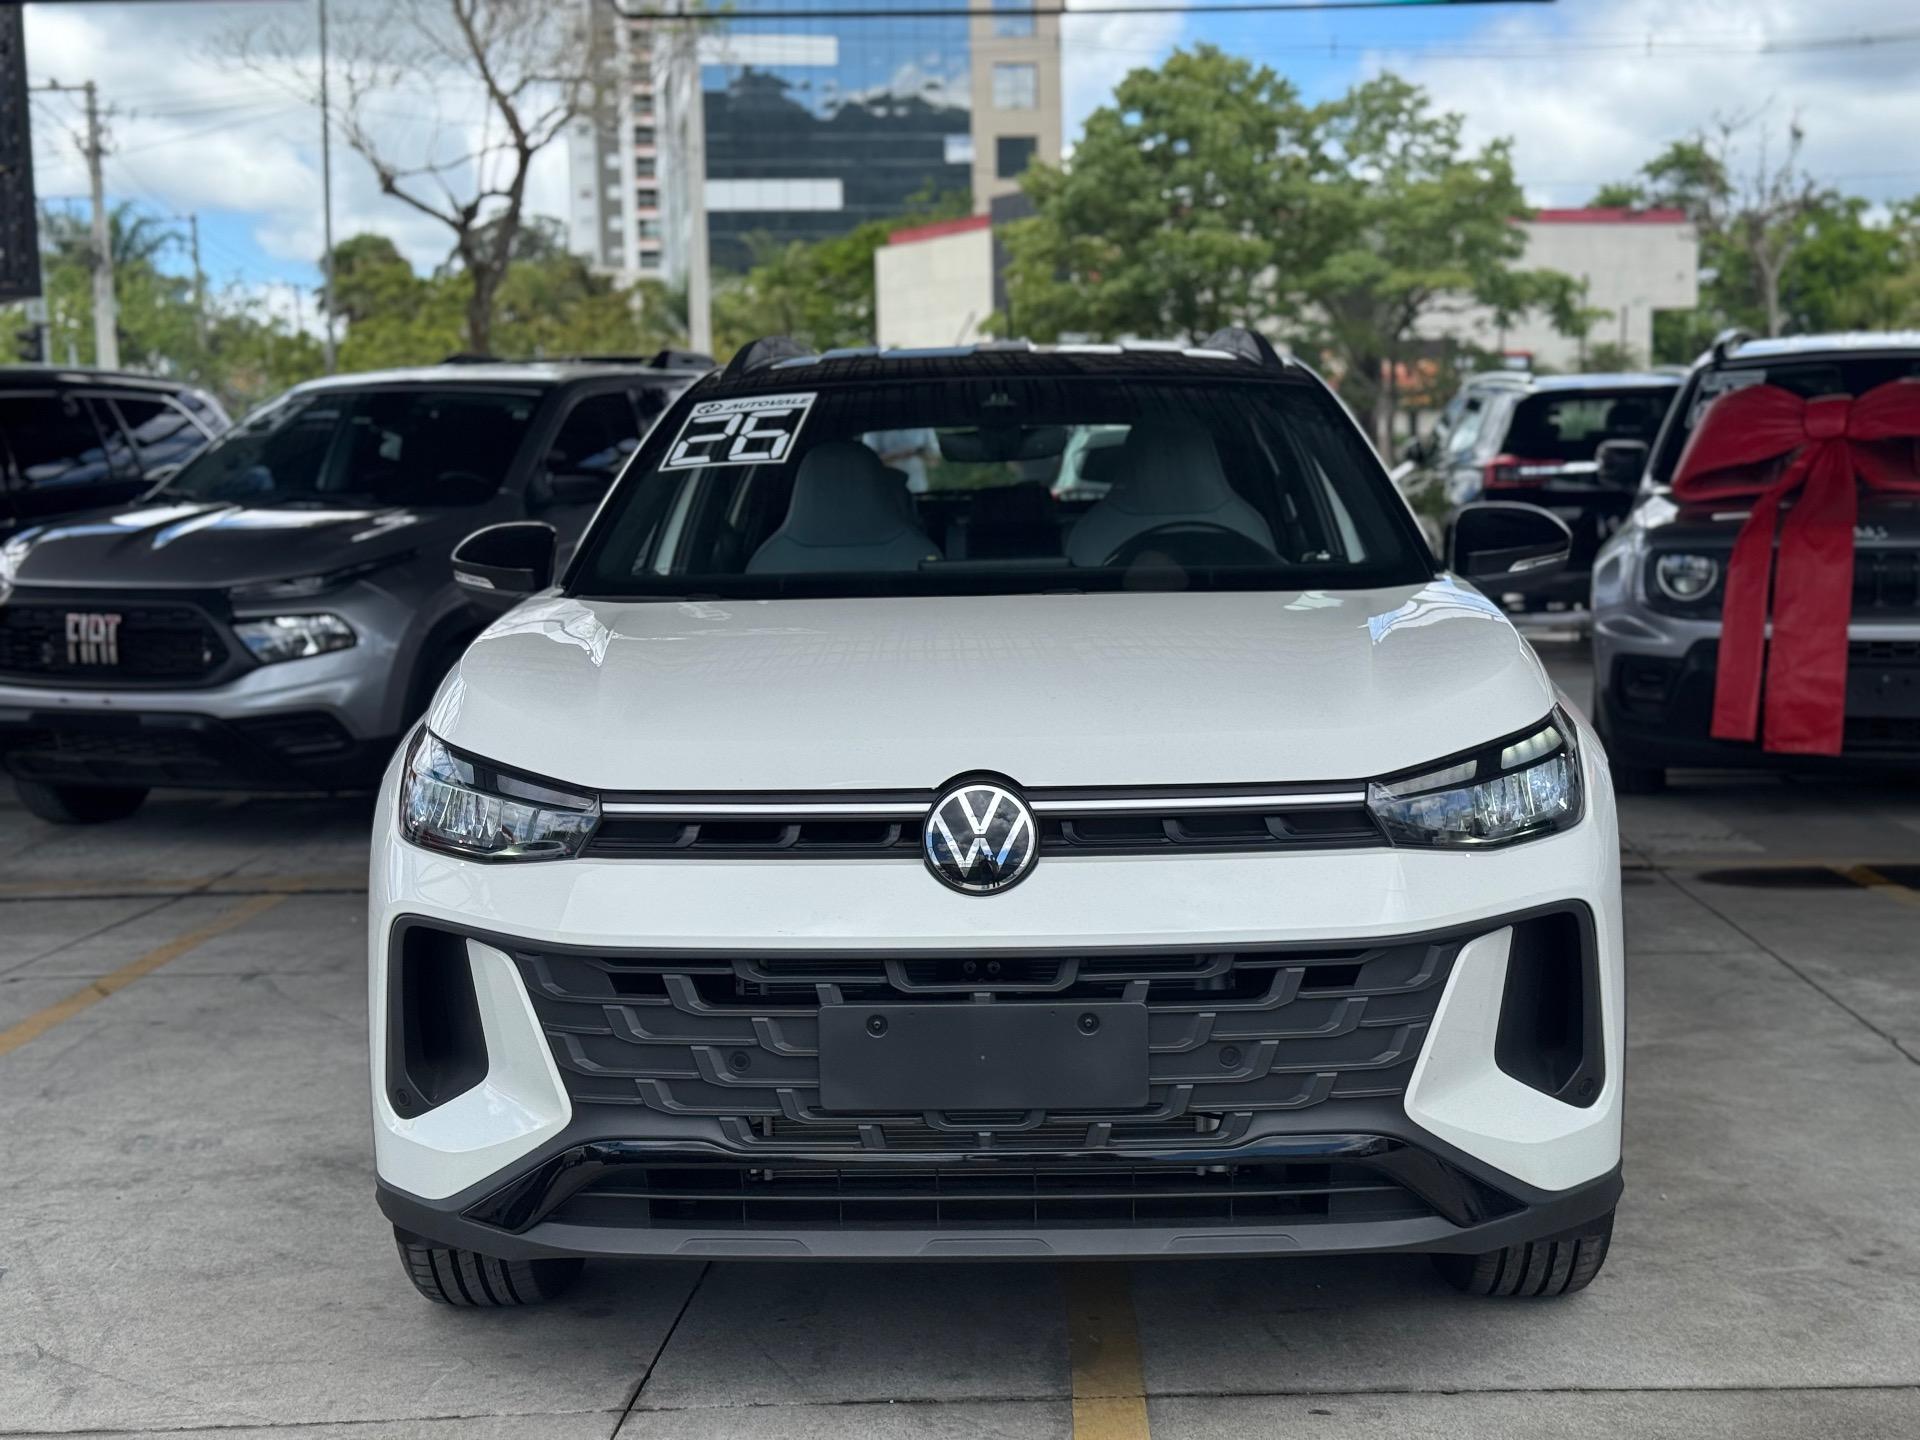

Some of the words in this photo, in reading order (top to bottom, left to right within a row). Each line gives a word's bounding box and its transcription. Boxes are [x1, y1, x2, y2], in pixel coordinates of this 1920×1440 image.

[725, 397, 812, 411] AUTOVALE
[669, 409, 793, 466] 26
[66, 613, 121, 665] FIAT
[926, 785, 1035, 891] VW
